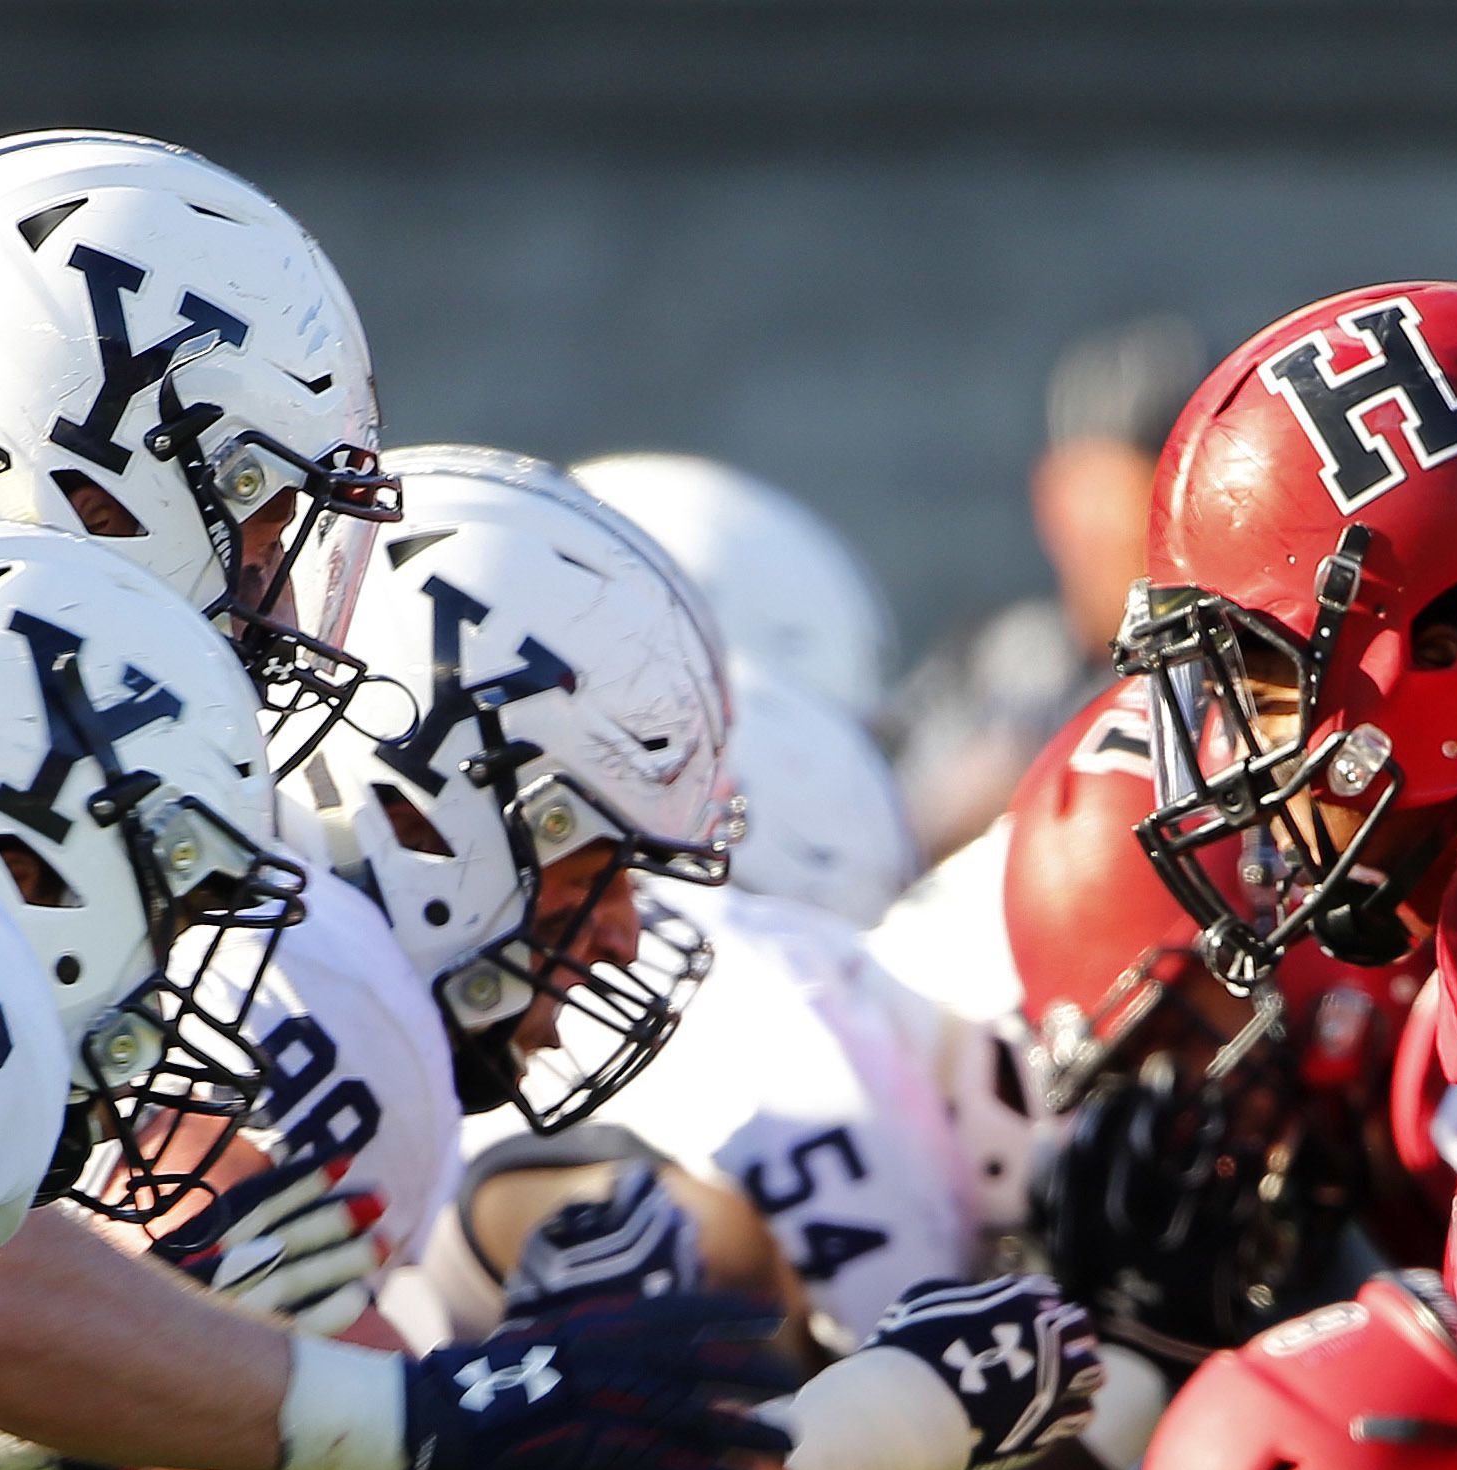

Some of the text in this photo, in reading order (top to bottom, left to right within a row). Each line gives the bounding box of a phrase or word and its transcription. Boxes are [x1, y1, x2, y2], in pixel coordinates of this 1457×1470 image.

[49, 244, 248, 475] Y
[375, 575, 576, 796] Y
[745, 1127, 890, 1282] 54
